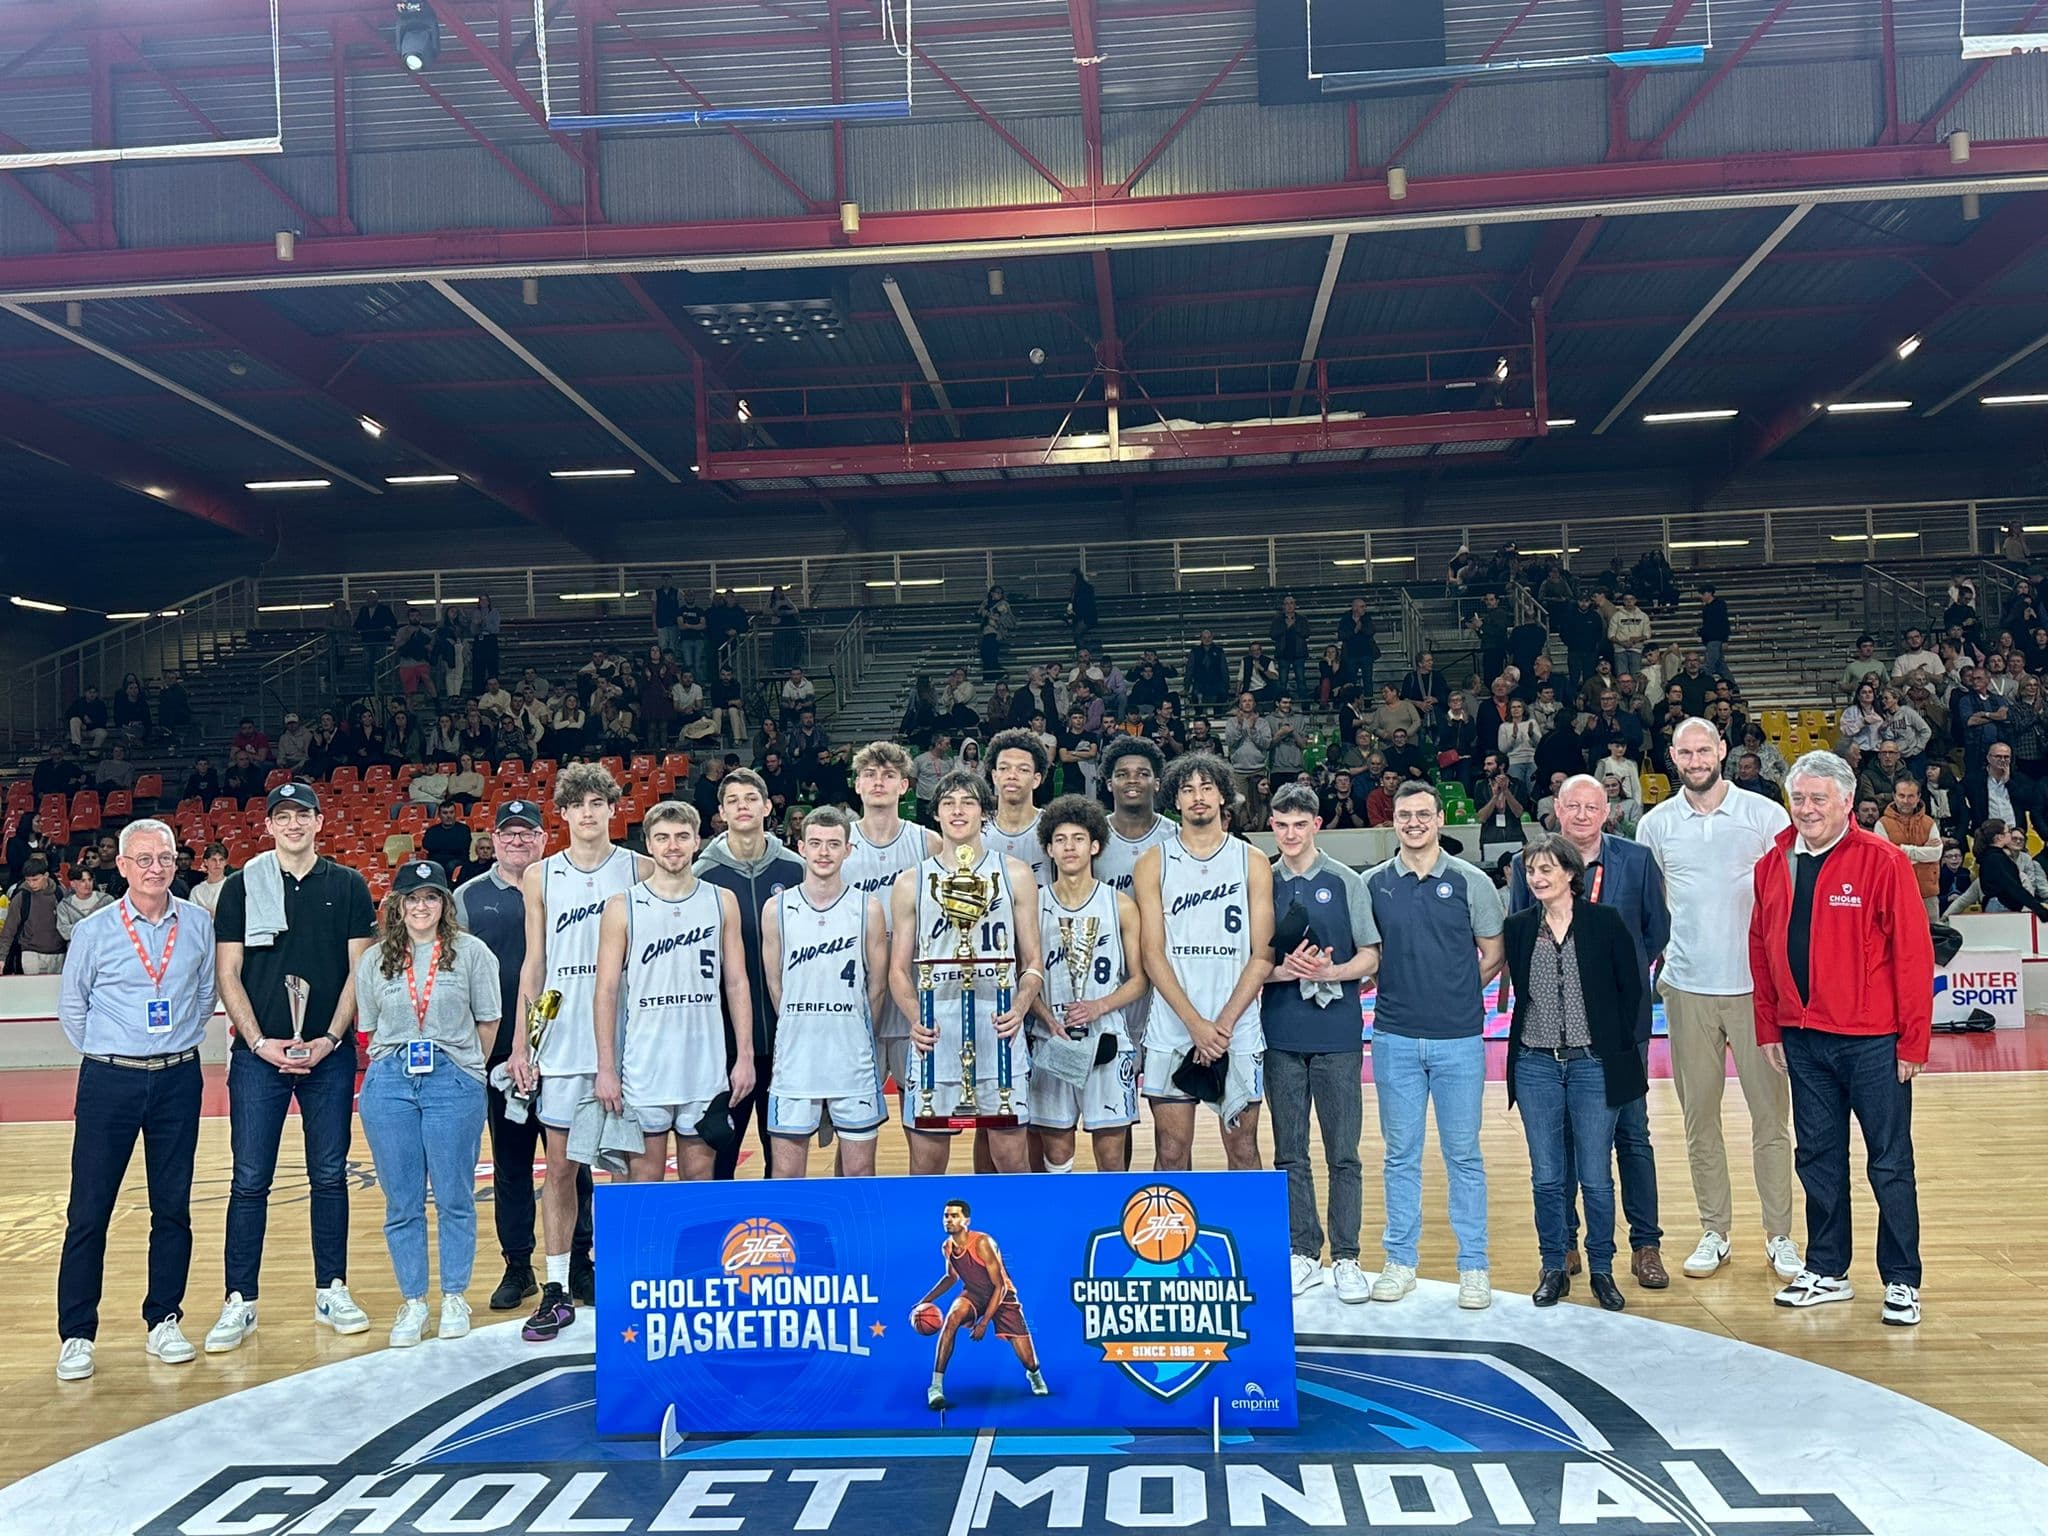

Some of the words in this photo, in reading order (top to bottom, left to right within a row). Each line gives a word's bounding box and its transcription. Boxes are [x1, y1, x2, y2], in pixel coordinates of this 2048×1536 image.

[1172, 882, 1241, 916] CHORALE
[556, 900, 606, 933] CHORA
[1224, 905, 1242, 934] 6
[981, 921, 1008, 952] 10
[700, 949, 715, 979] 5
[840, 959, 856, 988] 4
[1094, 957, 1111, 985] 8
[1953, 972, 2017, 988] INTER
[640, 994, 714, 1008] STERIFLOW
[1953, 989, 2018, 1006] SPORT
[630, 1278, 740, 1310] CHOLET
[751, 1274, 879, 1307] MONDIAL
[1073, 1281, 1153, 1302] CHOLET
[1161, 1280, 1253, 1301] MONDIAL
[646, 1307, 871, 1362] BASKETBALL
[1085, 1304, 1248, 1340] BASKETBALL
[1132, 1345, 1166, 1357] SINCE
[1169, 1345, 1195, 1357] 1982
[1231, 1397, 1280, 1411] emprint
[177, 1468, 887, 1536] CHOLET
[971, 1461, 1815, 1528] MONDIAL
